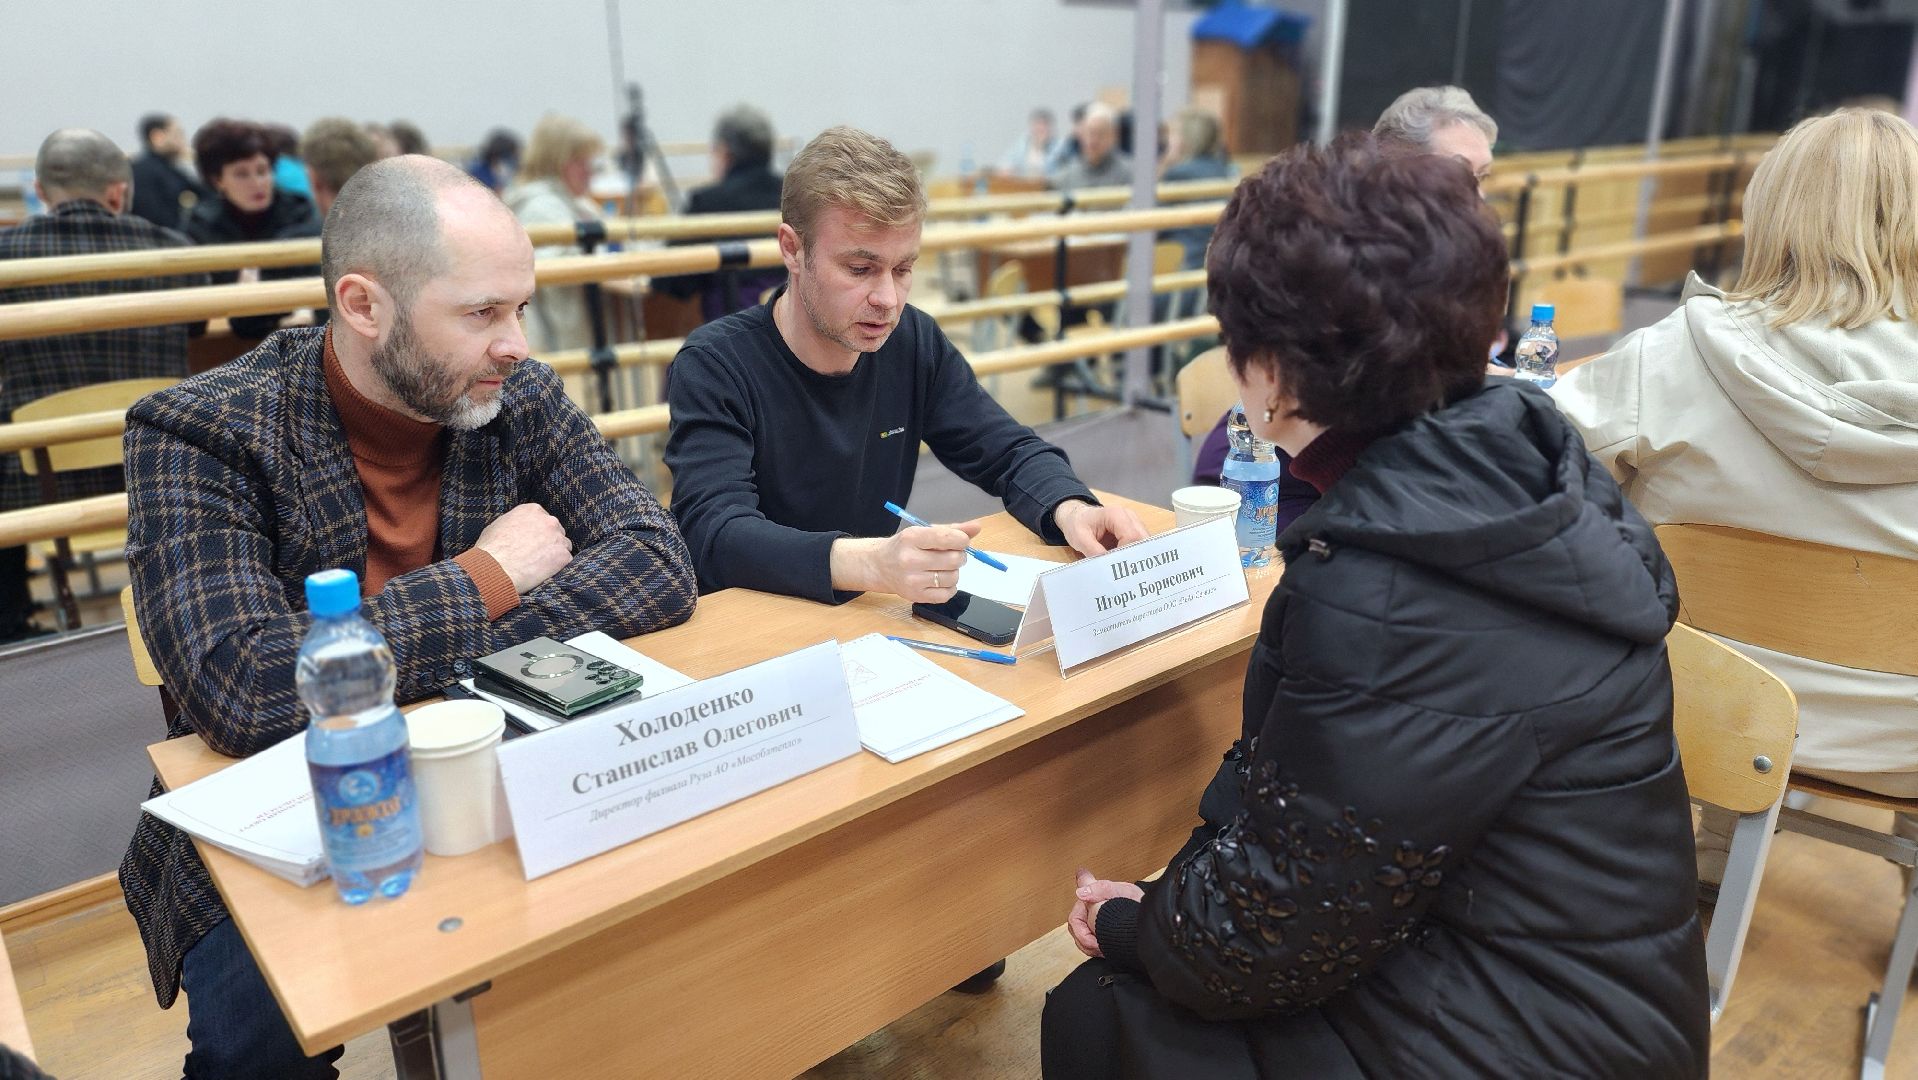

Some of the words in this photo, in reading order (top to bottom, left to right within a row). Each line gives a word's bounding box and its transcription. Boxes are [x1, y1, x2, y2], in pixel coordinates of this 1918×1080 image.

[1095, 590, 1137, 612] Игорь
[1138, 565, 1205, 597] Борисович
[1110, 548, 1180, 581] Шатохин
[614, 688, 754, 746] Холоденко
[572, 741, 698, 794] Станислав
[703, 703, 803, 748] Олегович
[589, 796, 643, 822] Директор
[689, 770, 712, 786] Руза
[713, 761, 729, 776] АО
